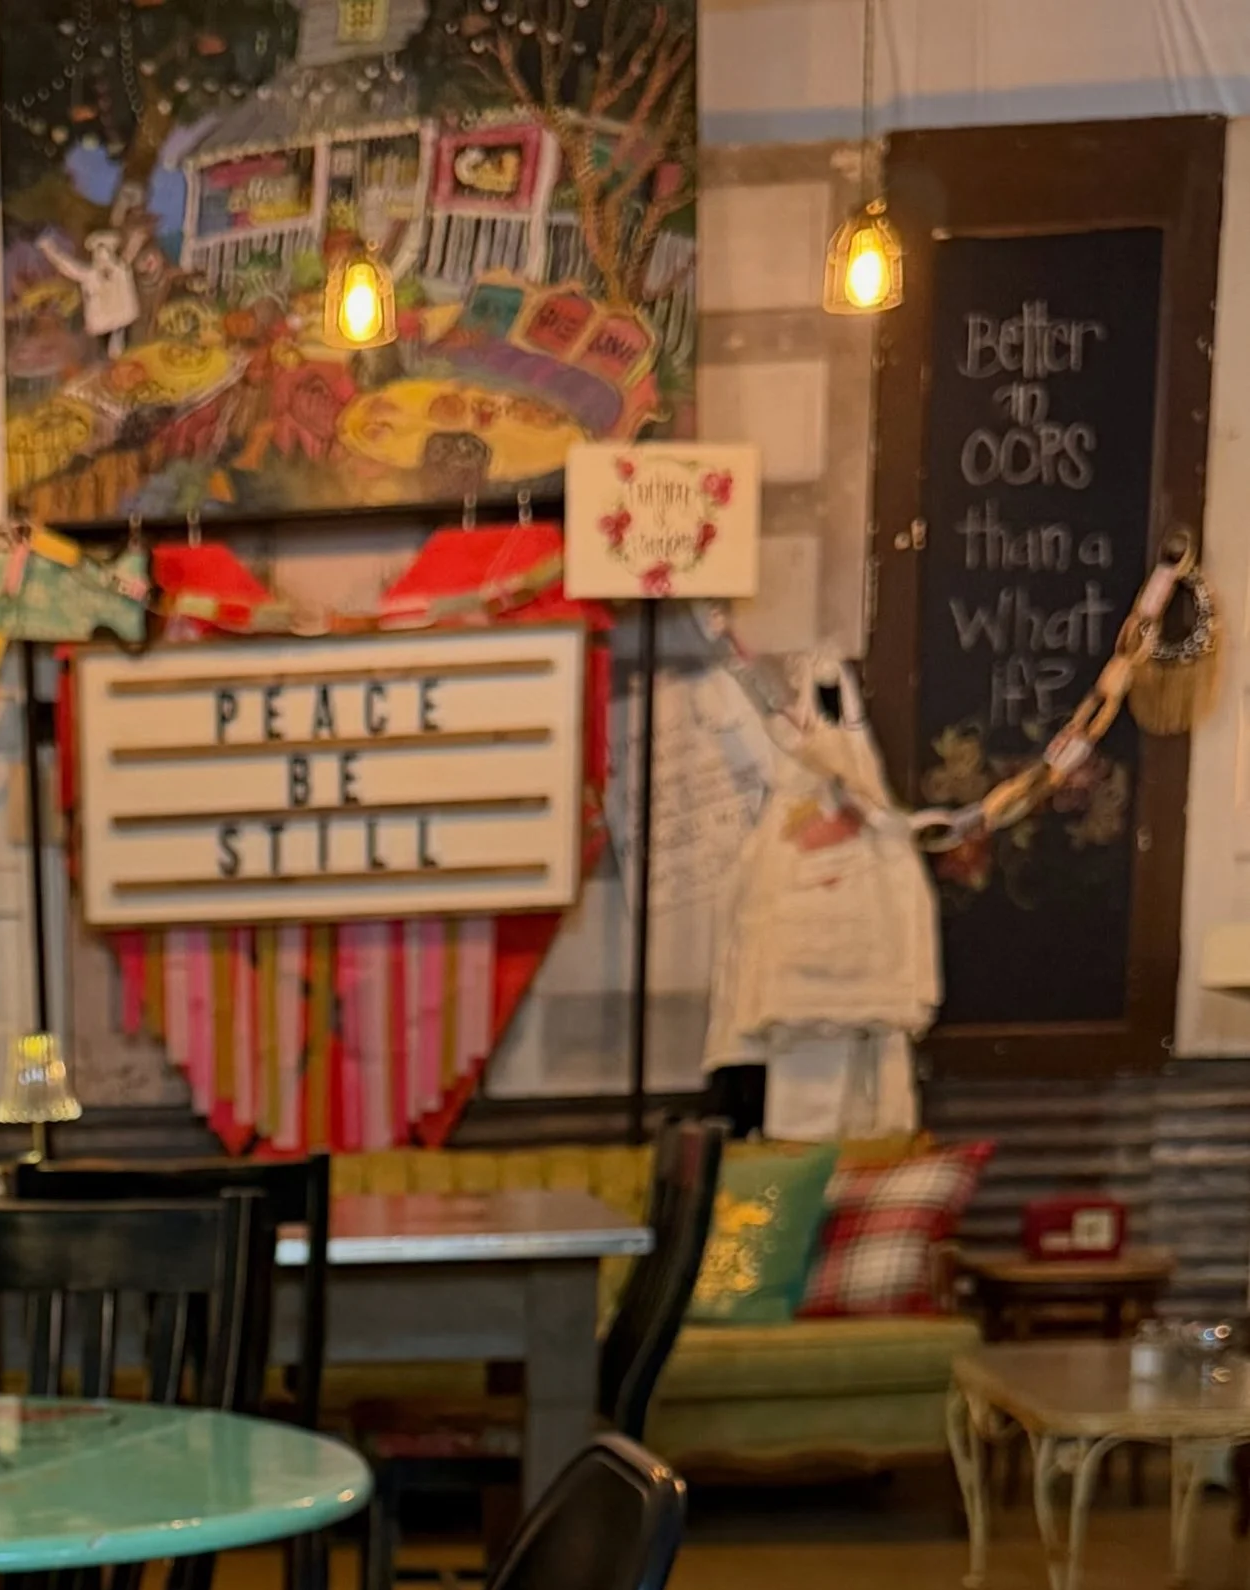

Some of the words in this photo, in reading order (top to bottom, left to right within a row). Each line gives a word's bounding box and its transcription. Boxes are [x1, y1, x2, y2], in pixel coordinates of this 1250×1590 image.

[957, 300, 1107, 379] Better
[955, 499, 1072, 573] than
[1078, 530, 1113, 569] a
[215, 676, 443, 745] PEACE
[288, 752, 362, 807] BE
[218, 815, 440, 879] STILL
